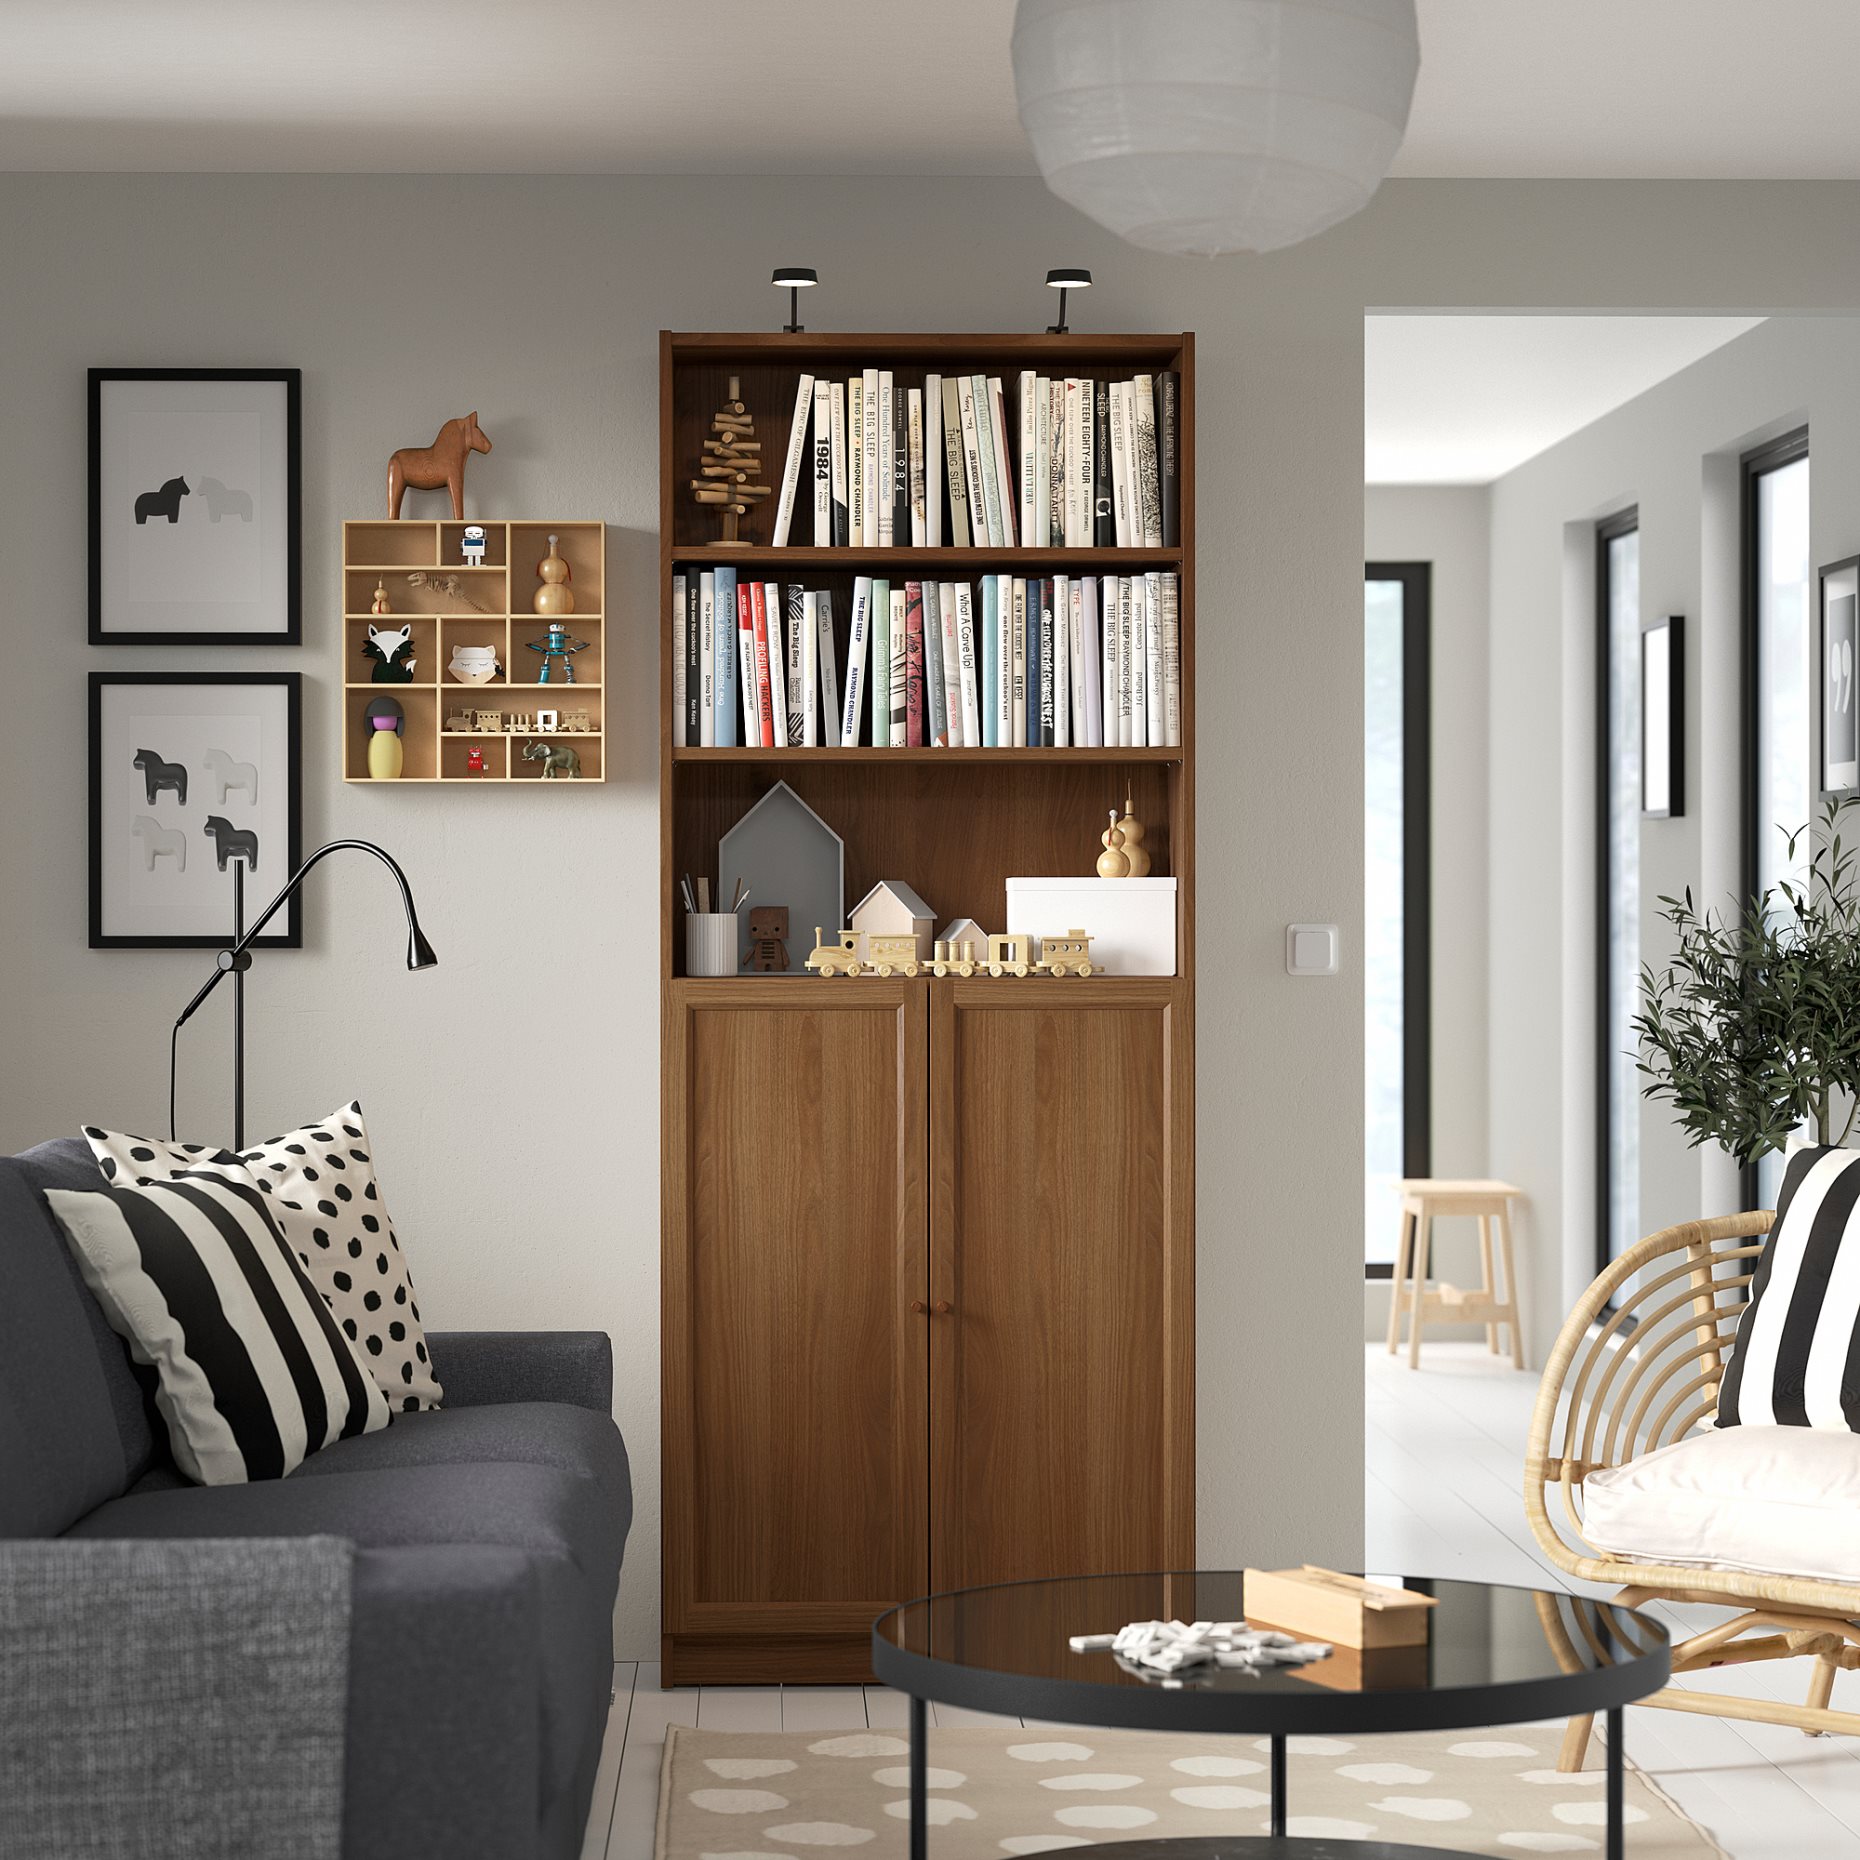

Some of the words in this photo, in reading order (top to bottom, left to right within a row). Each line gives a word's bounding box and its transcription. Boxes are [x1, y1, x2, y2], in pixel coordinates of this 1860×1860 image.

[866, 391, 875, 406] THE
[881, 386, 890, 403] One
[1081, 381, 1091, 423] NINETEEN
[1096, 393, 1106, 417] SLEEP
[1111, 393, 1121, 410] THE
[866, 411, 875, 427] BIG
[881, 404, 890, 437] Hundred
[1112, 411, 1121, 426] BIG
[866, 432, 875, 457] SLEEP
[881, 439, 890, 458] Years
[946, 428, 957, 446] THE
[1113, 427, 1123, 452] SLEEP
[816, 437, 829, 481] 1984
[881, 460, 890, 469] of
[948, 450, 958, 466] BIG
[1081, 426, 1091, 484] EIGHTY-FOUR
[881, 471, 890, 501] Solitude
[949, 471, 960, 501] SLEEP
[960, 593, 970, 616] What
[1122, 587, 1130, 600] THE
[821, 604, 830, 633] Carrie's
[1107, 603, 1115, 620] THE
[1122, 601, 1130, 615] BIG
[791, 622, 799, 635] The
[855, 622, 863, 642] SLEEP
[961, 626, 972, 652] Carve
[1107, 622, 1115, 636] BIG
[1122, 616, 1130, 639] SLEEP
[791, 636, 799, 649] Big
[1107, 638, 1115, 662] SLEEP
[757, 641, 768, 683] PROFILING
[791, 650, 799, 668] Sleep
[877, 640, 887, 671] Grimm's
[963, 654, 973, 669] Up!
[1122, 640, 1130, 676] RAYMOND
[849, 667, 858, 699] RAYMOND
[877, 672, 887, 691] Fairy
[760, 685, 770, 722] HACKERS
[877, 691, 887, 710] Tales
[1122, 677, 1130, 716] CHANDLER
[845, 700, 855, 735] CHANDLER
